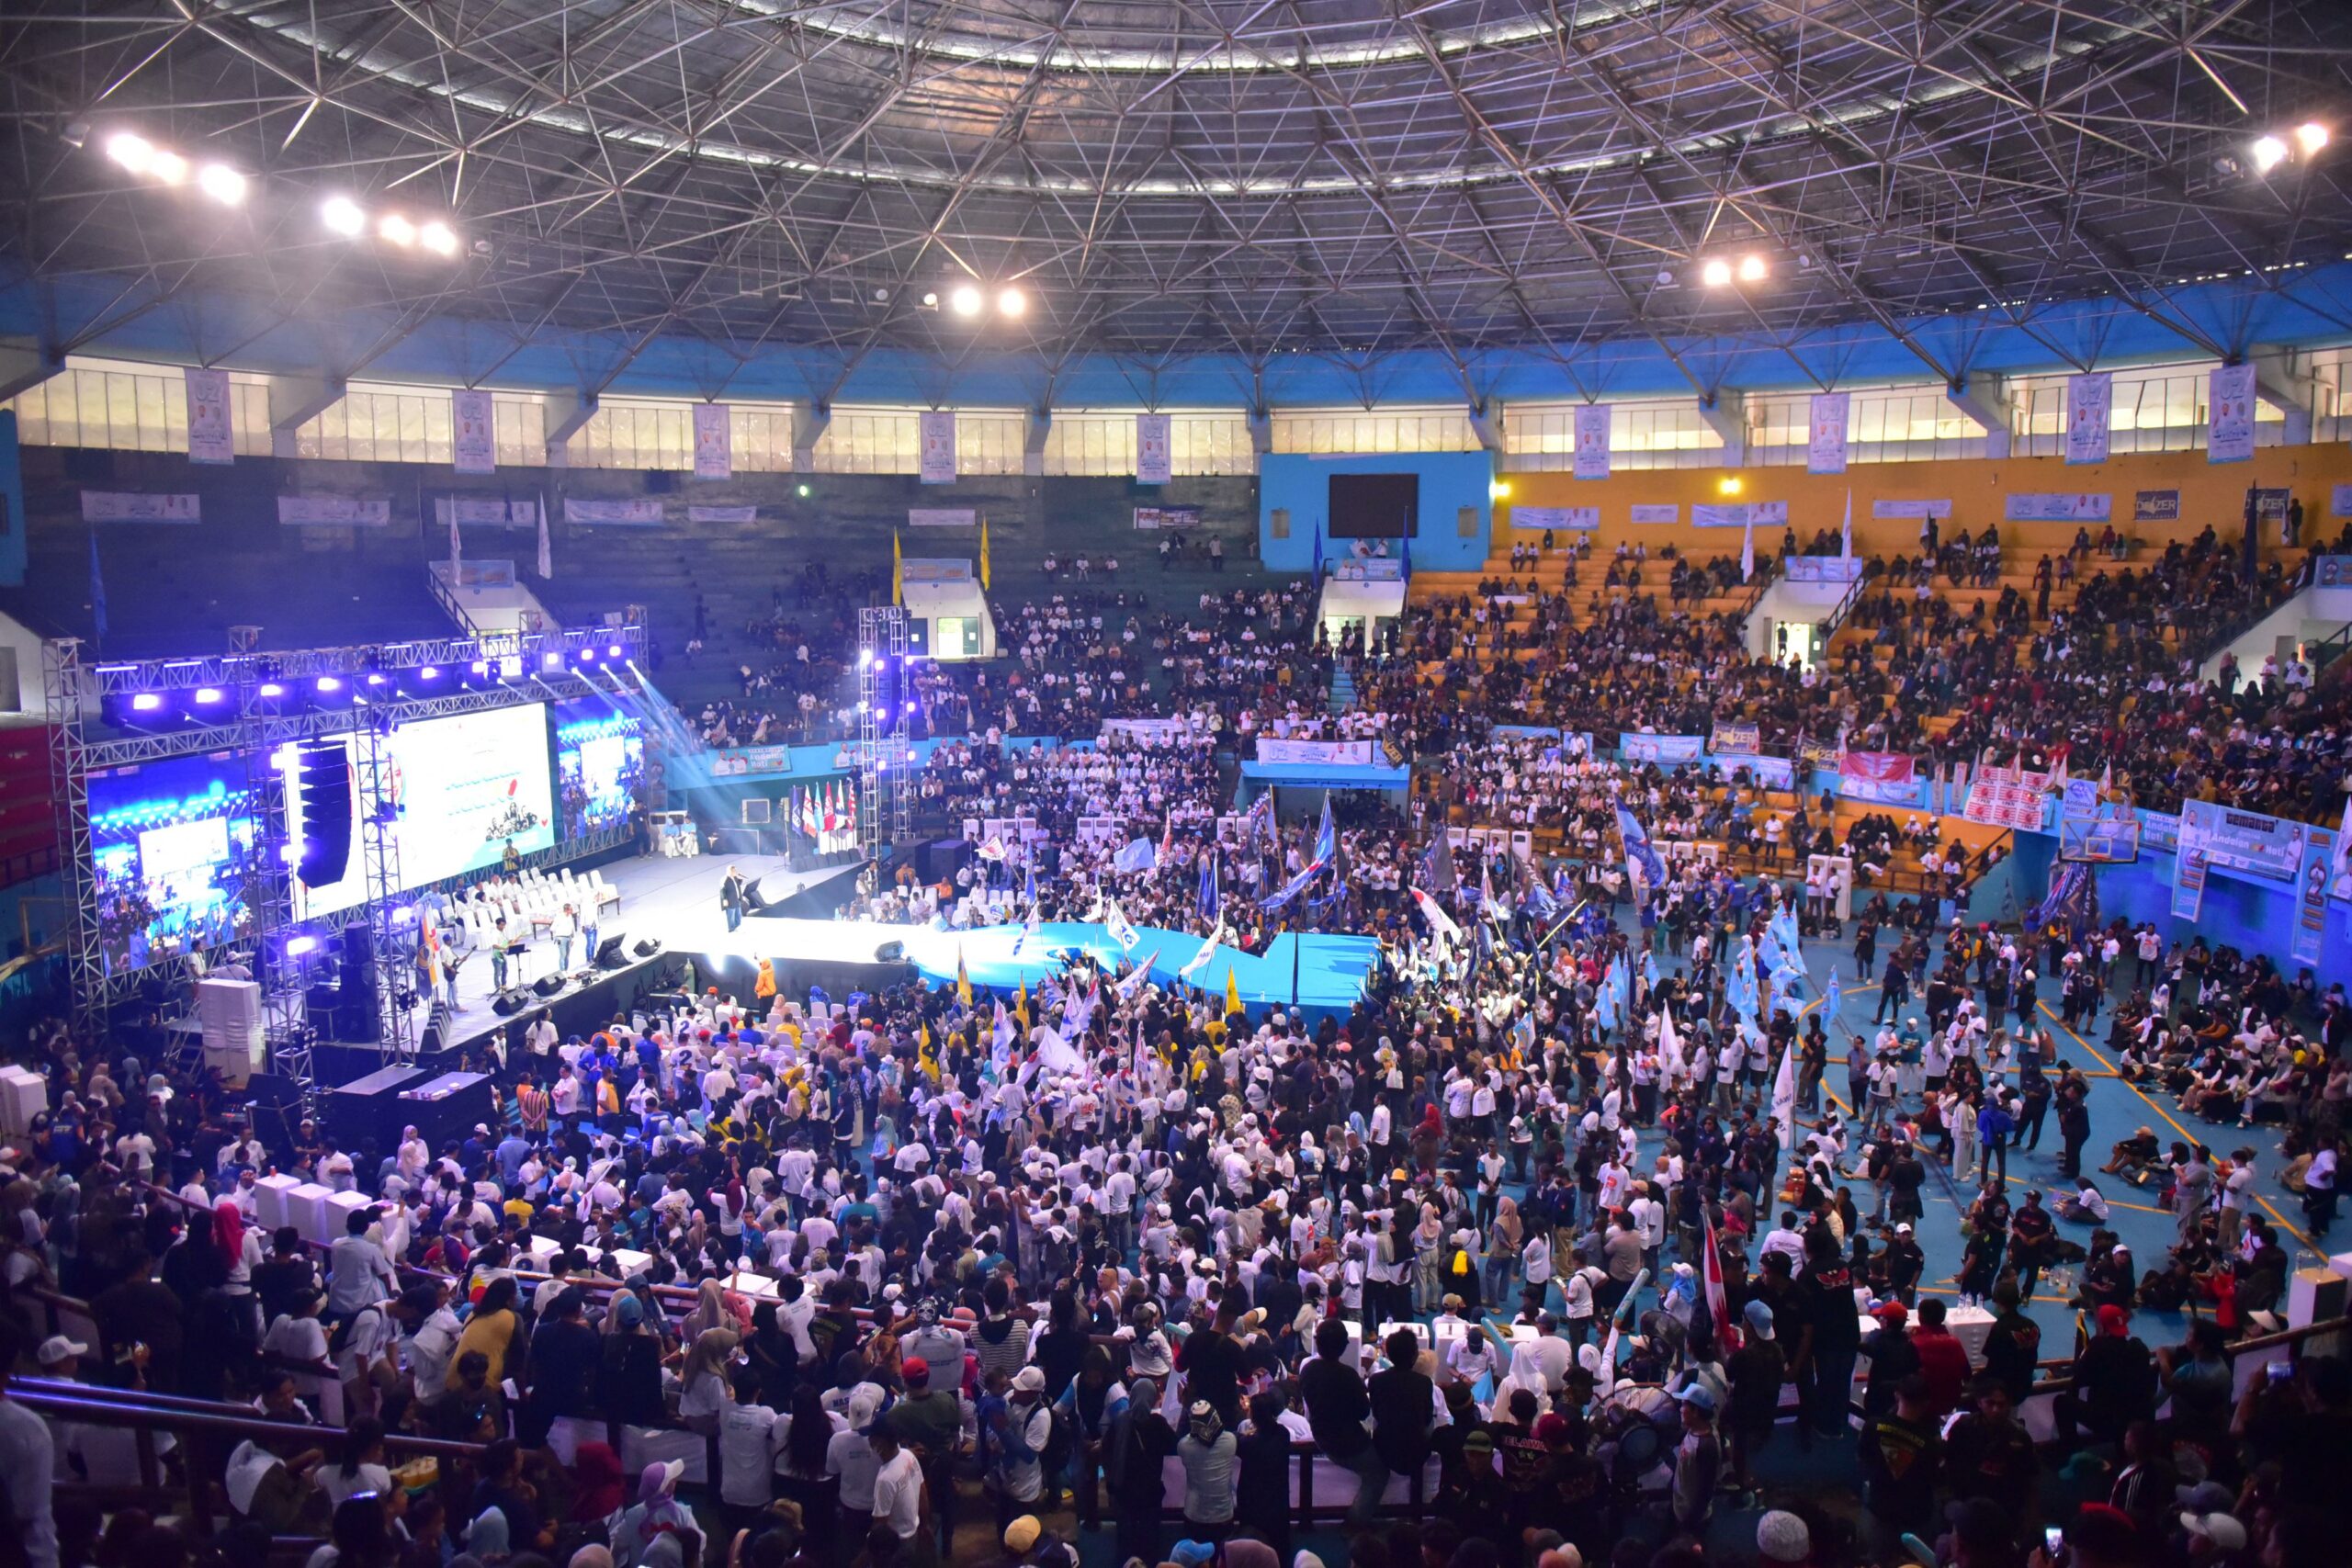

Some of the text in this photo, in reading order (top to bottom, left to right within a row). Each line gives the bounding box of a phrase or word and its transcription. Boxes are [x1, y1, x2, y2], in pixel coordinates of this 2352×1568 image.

[2211, 833, 2249, 850] Andalan
[2266, 844, 2285, 857] Hati
[679, 1049, 692, 1066] 2
